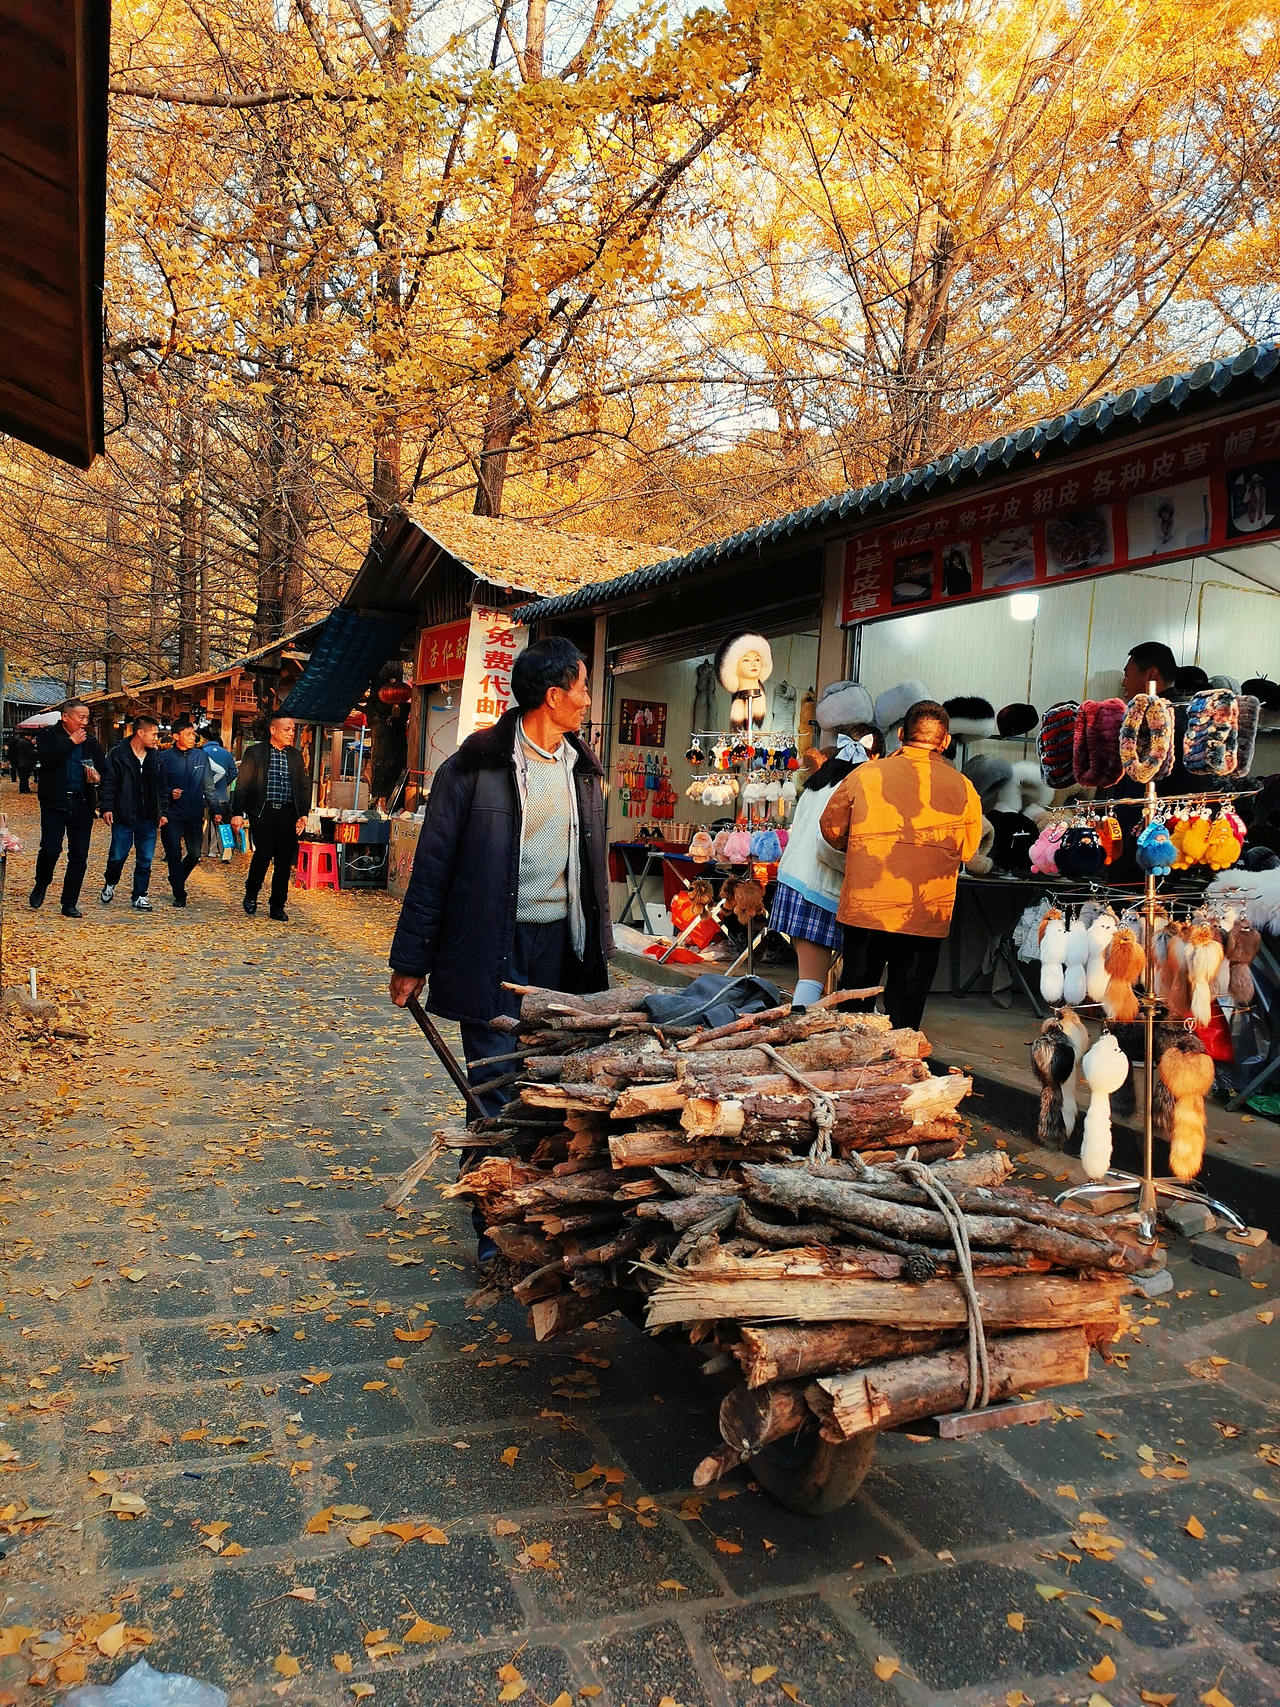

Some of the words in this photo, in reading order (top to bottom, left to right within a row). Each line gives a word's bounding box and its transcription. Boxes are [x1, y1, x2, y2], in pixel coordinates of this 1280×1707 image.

[891, 516, 950, 550] 狐狸皮
[1091, 440, 1211, 500] 各种皮草
[1221, 419, 1280, 462] 帽子
[848, 534, 884, 613] 口岸皮草
